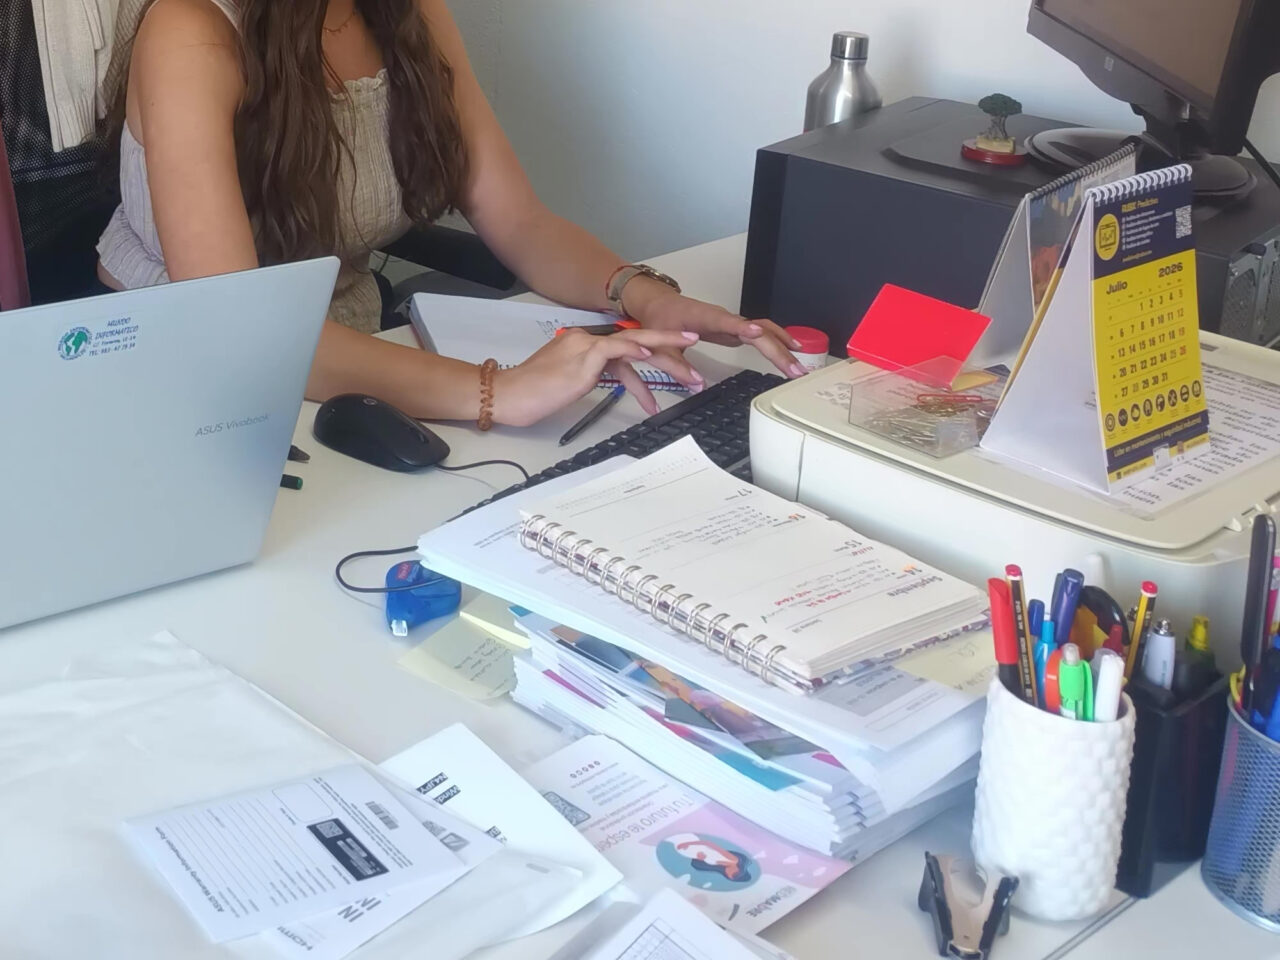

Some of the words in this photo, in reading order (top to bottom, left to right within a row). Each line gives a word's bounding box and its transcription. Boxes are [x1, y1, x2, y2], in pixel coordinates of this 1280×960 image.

[1158, 262, 1183, 278] 2026
[1106, 281, 1128, 295] Julio
[195, 423, 223, 437] ASUS
[640, 805, 679, 826] futuro
